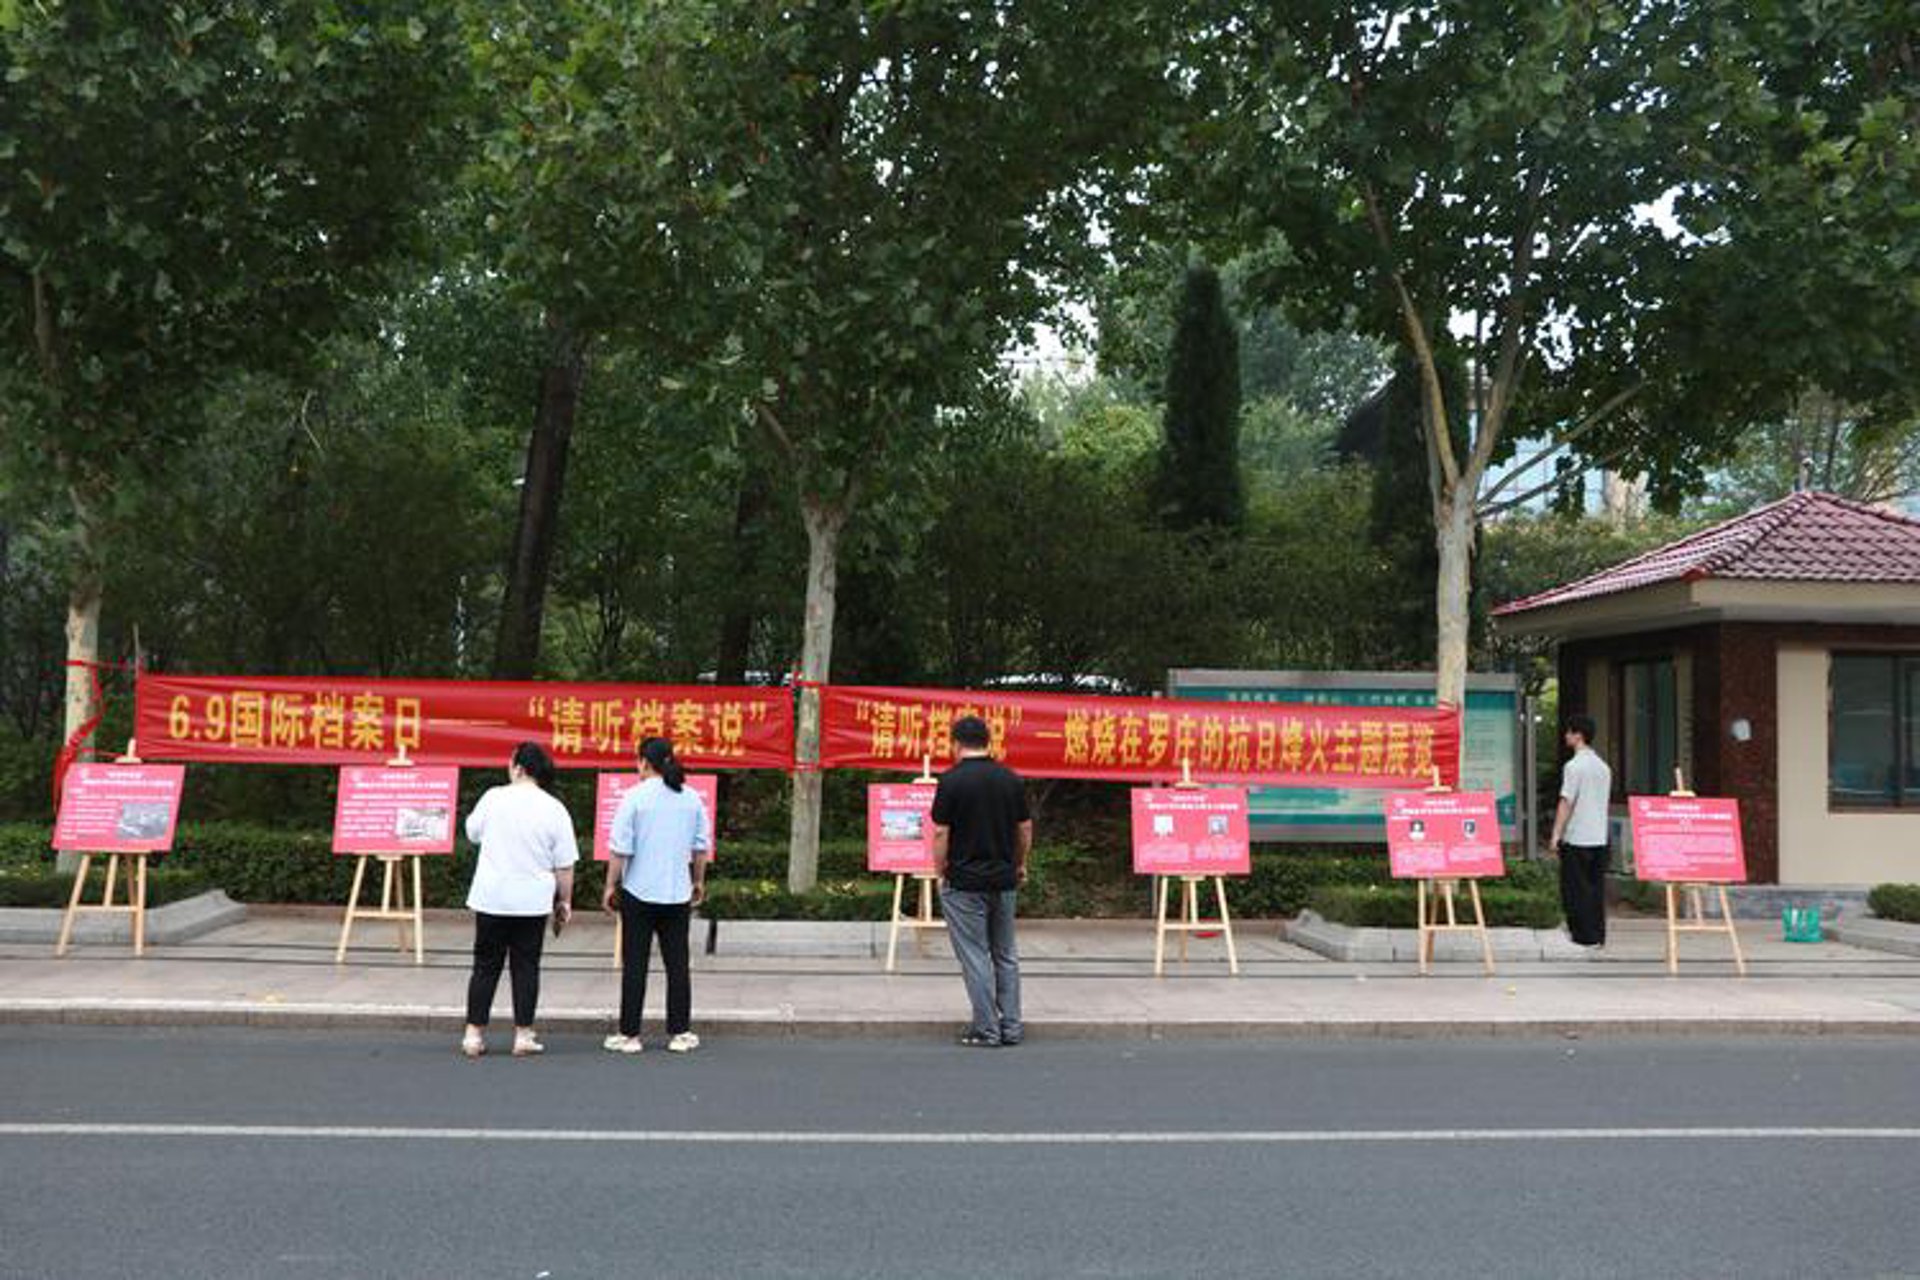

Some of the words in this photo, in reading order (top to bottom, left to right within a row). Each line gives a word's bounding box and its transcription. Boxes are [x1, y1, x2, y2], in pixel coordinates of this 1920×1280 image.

[855, 699, 1435, 778] “请听档说”—燃烧在罗庄的抗日烽火主题展览
